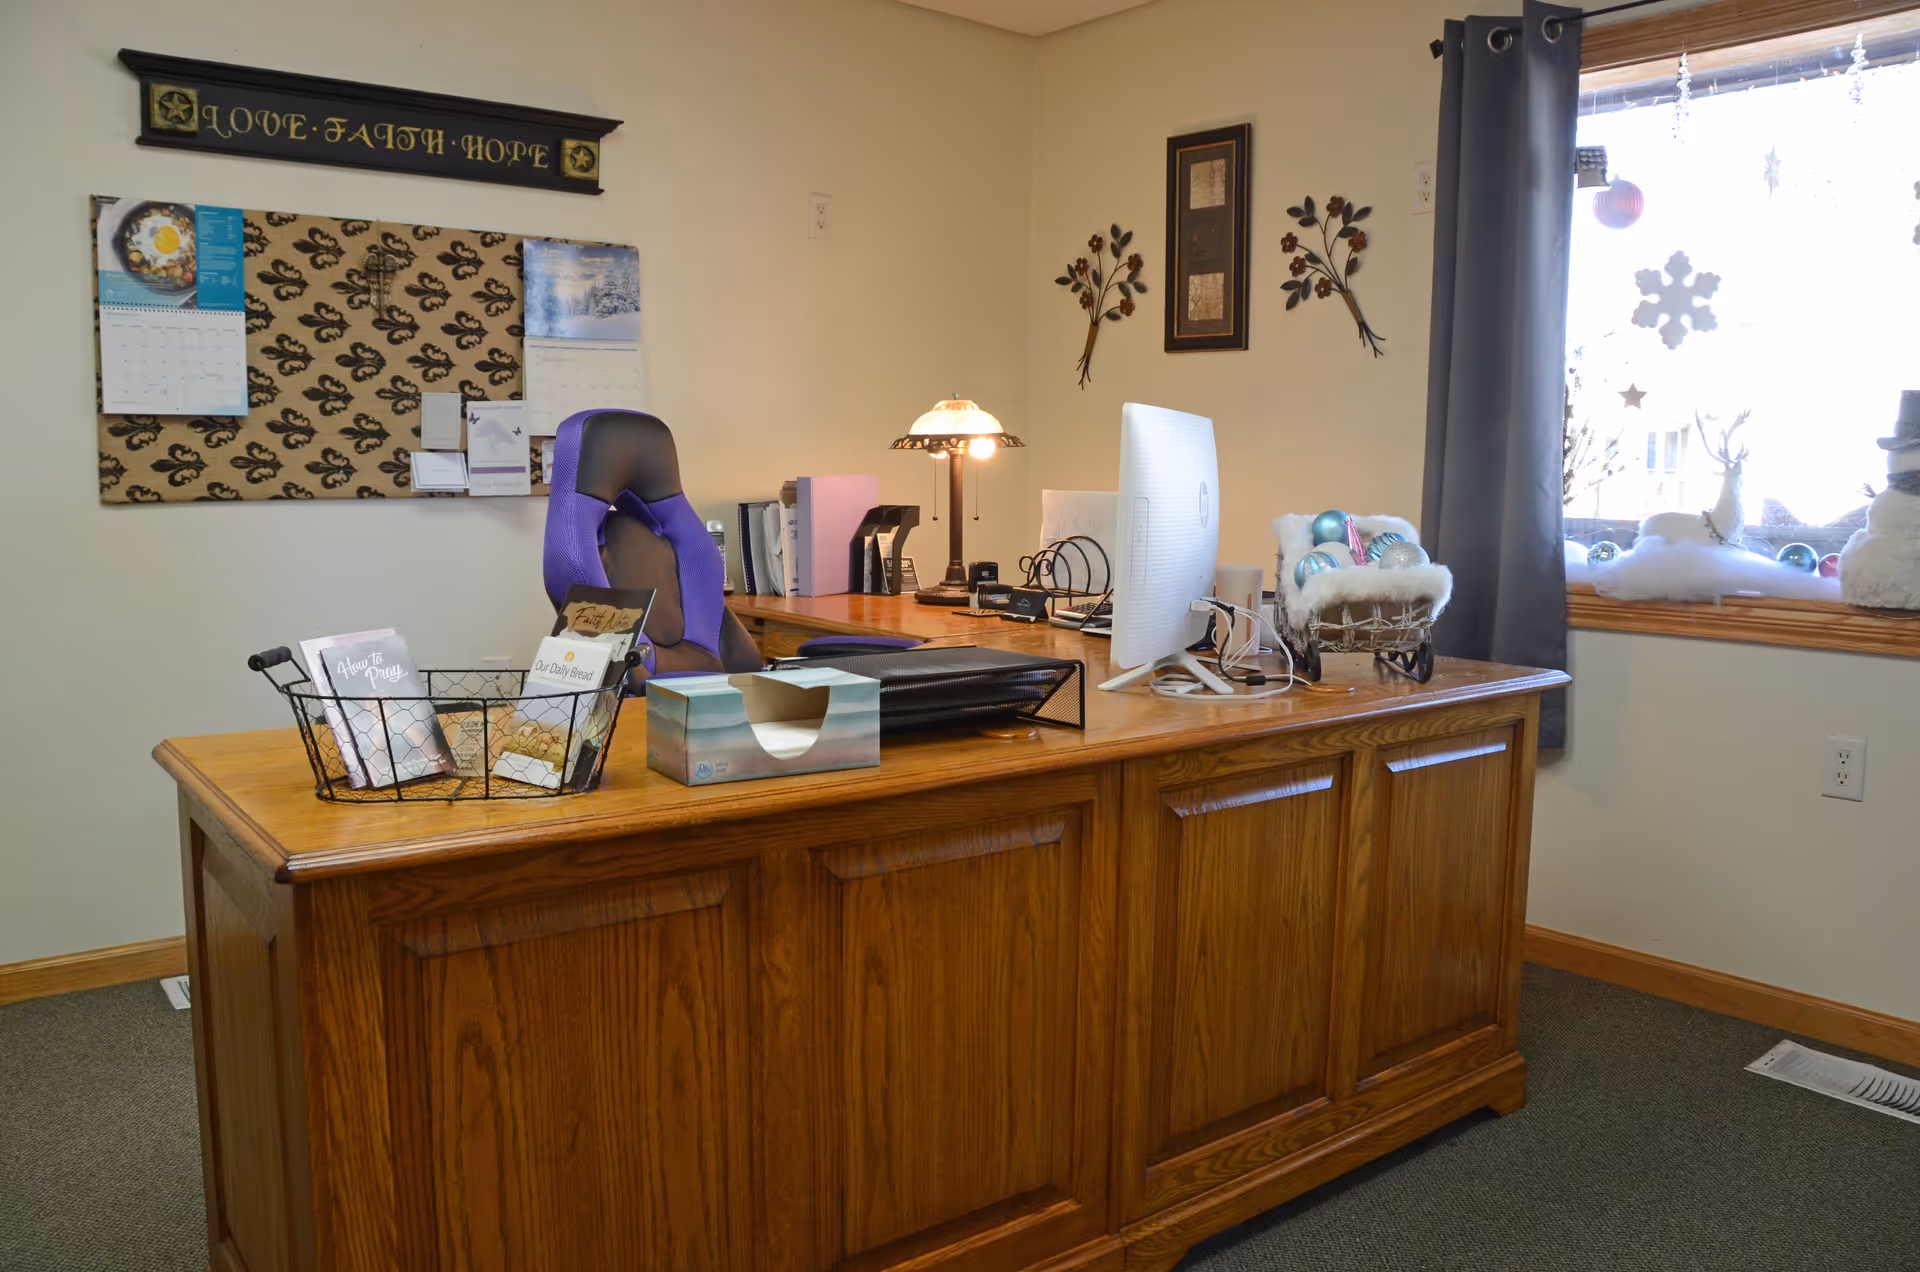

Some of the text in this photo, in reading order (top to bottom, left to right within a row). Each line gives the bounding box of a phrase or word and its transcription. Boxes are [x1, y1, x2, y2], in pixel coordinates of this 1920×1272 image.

[202, 104, 550, 169] LOVE FAITH HOPE
[571, 605, 606, 630] Faith
[337, 652, 384, 680] How to
[364, 664, 409, 690] Pray
[535, 659, 595, 681] Our Daily Bread
